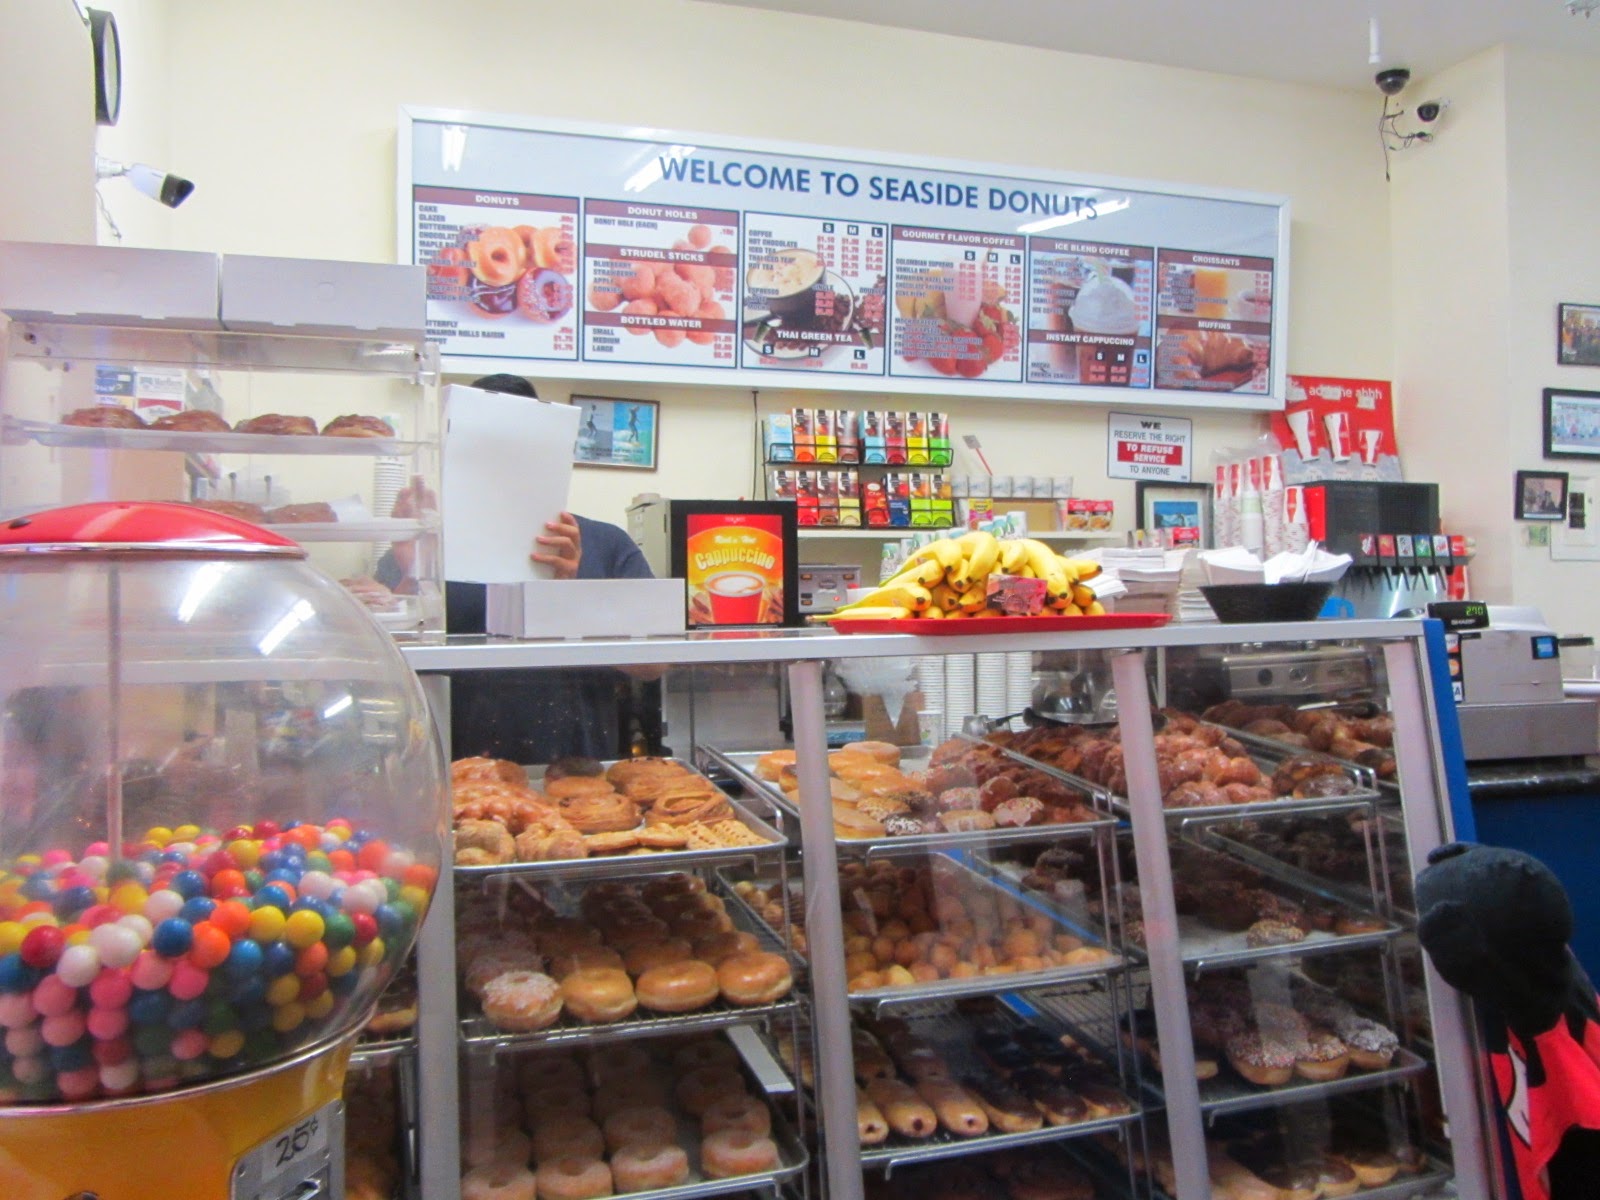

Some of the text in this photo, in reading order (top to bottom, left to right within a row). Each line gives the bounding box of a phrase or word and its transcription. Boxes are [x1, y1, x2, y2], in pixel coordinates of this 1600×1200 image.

[658, 156, 1098, 220] WELCOME TO SEASIDE DONUTS
[475, 194, 520, 206] DONUTS
[419, 205, 438, 213] CAKE
[628, 206, 698, 220] DONUT HOLES
[594, 217, 616, 226] DONUT
[419, 240, 443, 248] MAPLE
[762, 239, 798, 248] CHOCOLATE
[902, 230, 1015, 247] GOURMET FLAVOR COFFEE
[1055, 242, 1130, 256] ICE BLEND COFFEE
[620, 248, 704, 262] STRUDEL STICKS
[1193, 255, 1240, 266] CROISSANTS
[593, 269, 637, 278] STRAWBERRY
[620, 316, 702, 329] BOTTLED WATER
[1198, 320, 1231, 330] MUFFINS
[592, 328, 615, 336] SMALL
[777, 330, 853, 342] THAI GREEN TEA
[592, 336, 620, 345] MEDIUM
[1046, 334, 1135, 346] INSTANT CAPPUCCINO
[592, 345, 614, 353] LARGE
[1140, 421, 1162, 430] WE
[1114, 430, 1186, 443] RESERVE THE RIGHT
[1126, 443, 1174, 455] TO REFUSE
[1133, 453, 1167, 464] SERVICE
[1130, 465, 1171, 475] TO ANYONE
[695, 547, 775, 570] Cappuccino
